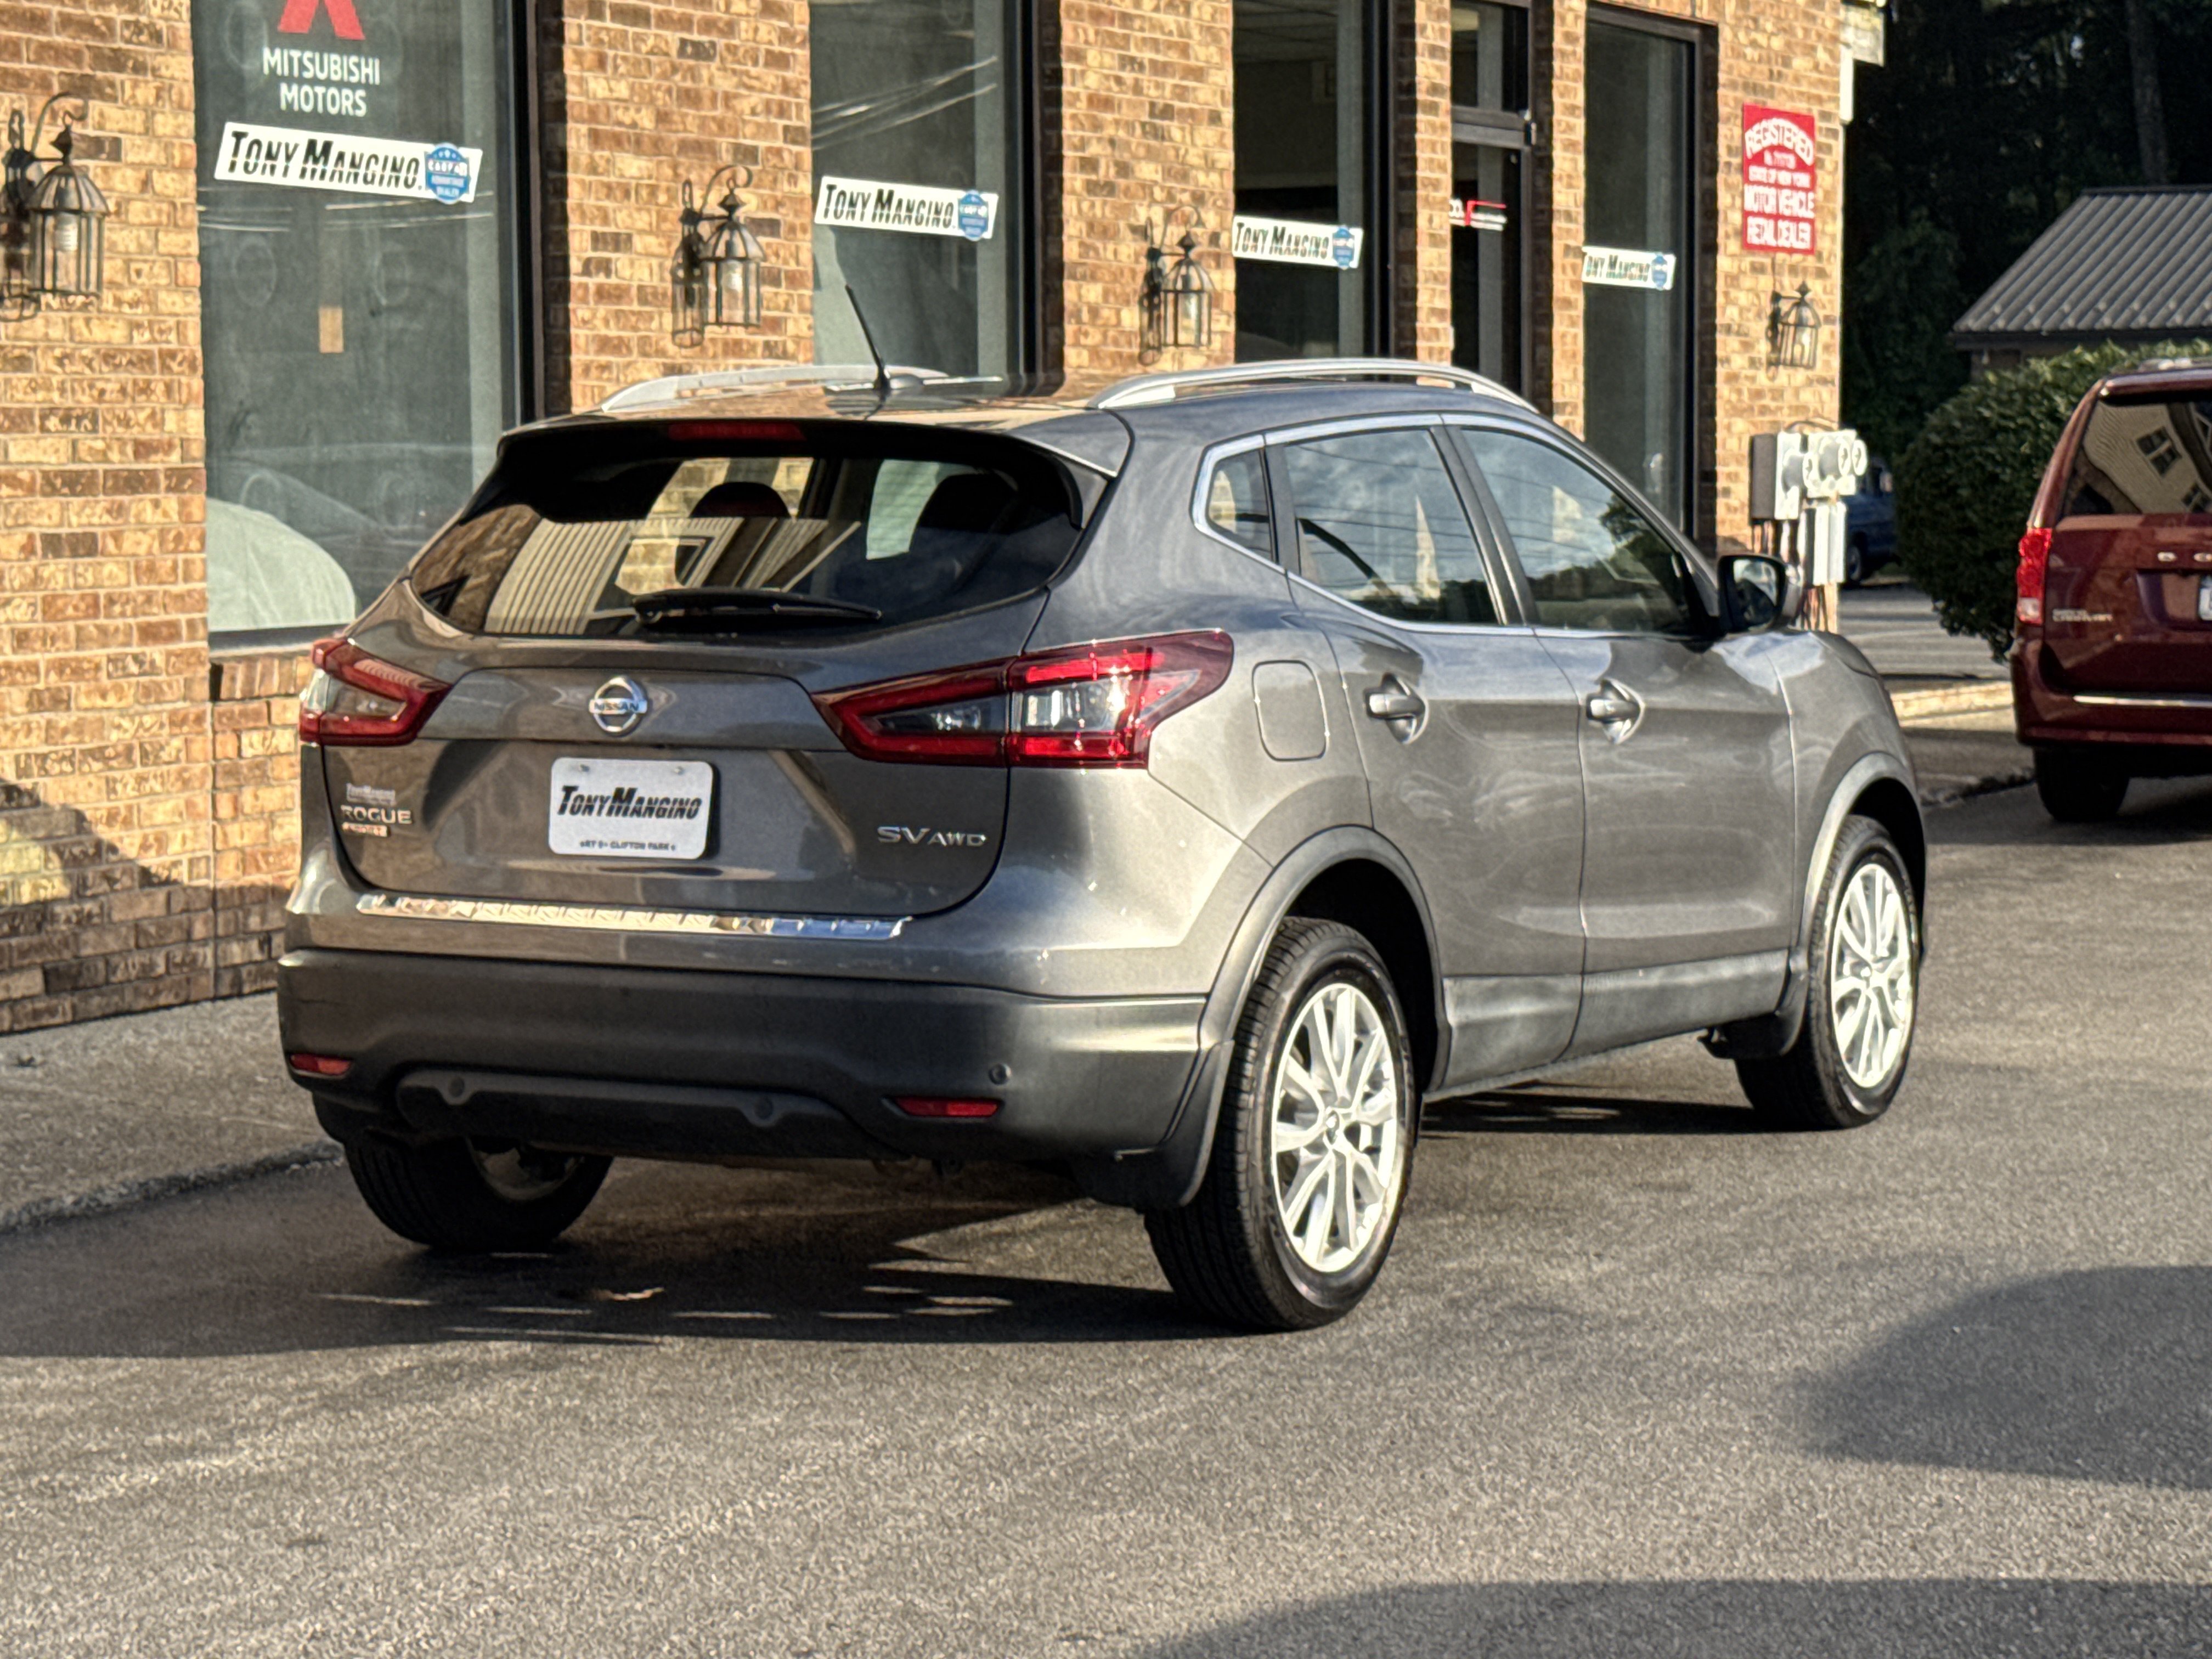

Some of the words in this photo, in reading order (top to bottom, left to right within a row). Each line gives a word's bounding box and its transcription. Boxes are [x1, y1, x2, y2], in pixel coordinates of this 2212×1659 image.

[262, 47, 380, 85] MITSUBISHI
[280, 82, 368, 117] MOTORS
[227, 130, 299, 179] TONY
[823, 183, 871, 222] TONY
[1234, 222, 1269, 255] TONY
[340, 804, 413, 825] ROGUE
[557, 785, 611, 817] TONY
[927, 831, 987, 847] AWD
